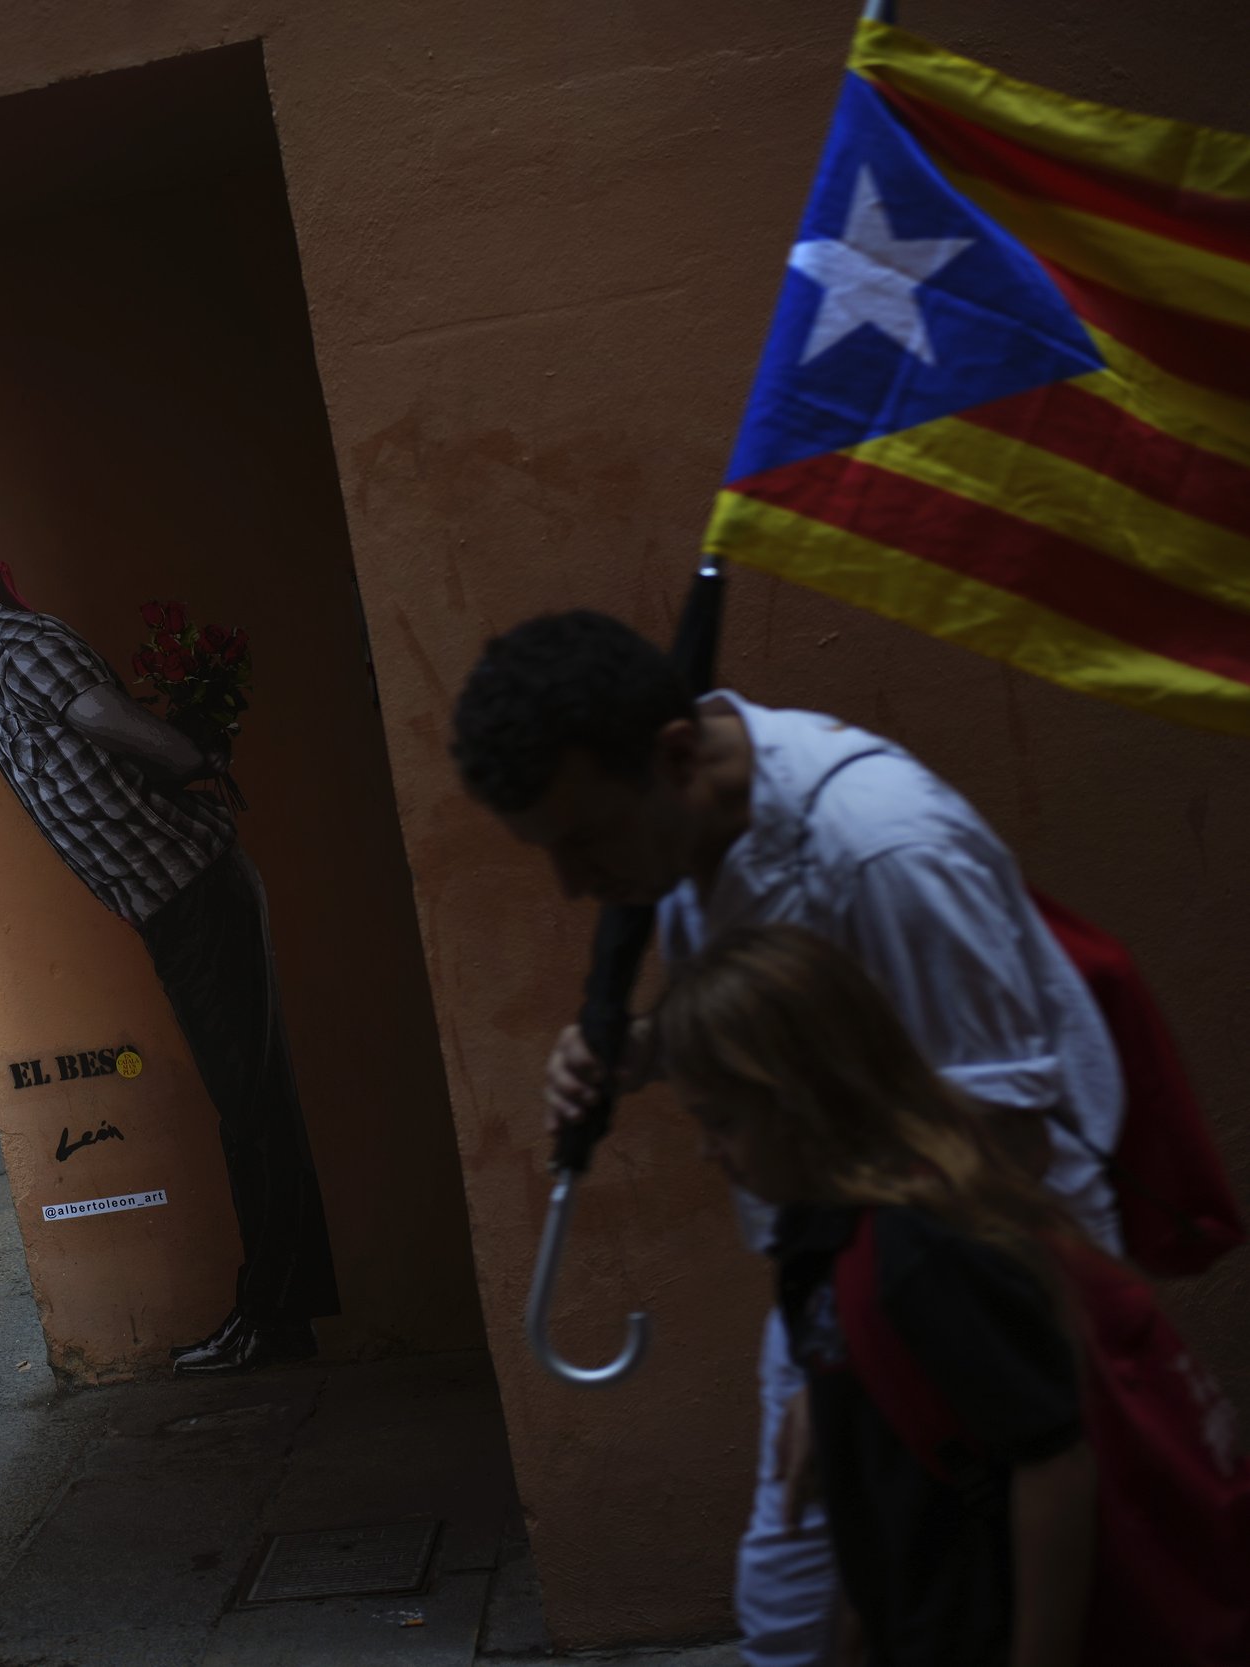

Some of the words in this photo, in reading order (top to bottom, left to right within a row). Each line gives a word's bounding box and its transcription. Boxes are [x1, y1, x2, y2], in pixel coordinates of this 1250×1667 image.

[9, 1059, 51, 1089] EL
[55, 1044, 140, 1081] BES
[55, 1120, 125, 1162] León
[44, 1190, 164, 1219] @albertoleon_art
